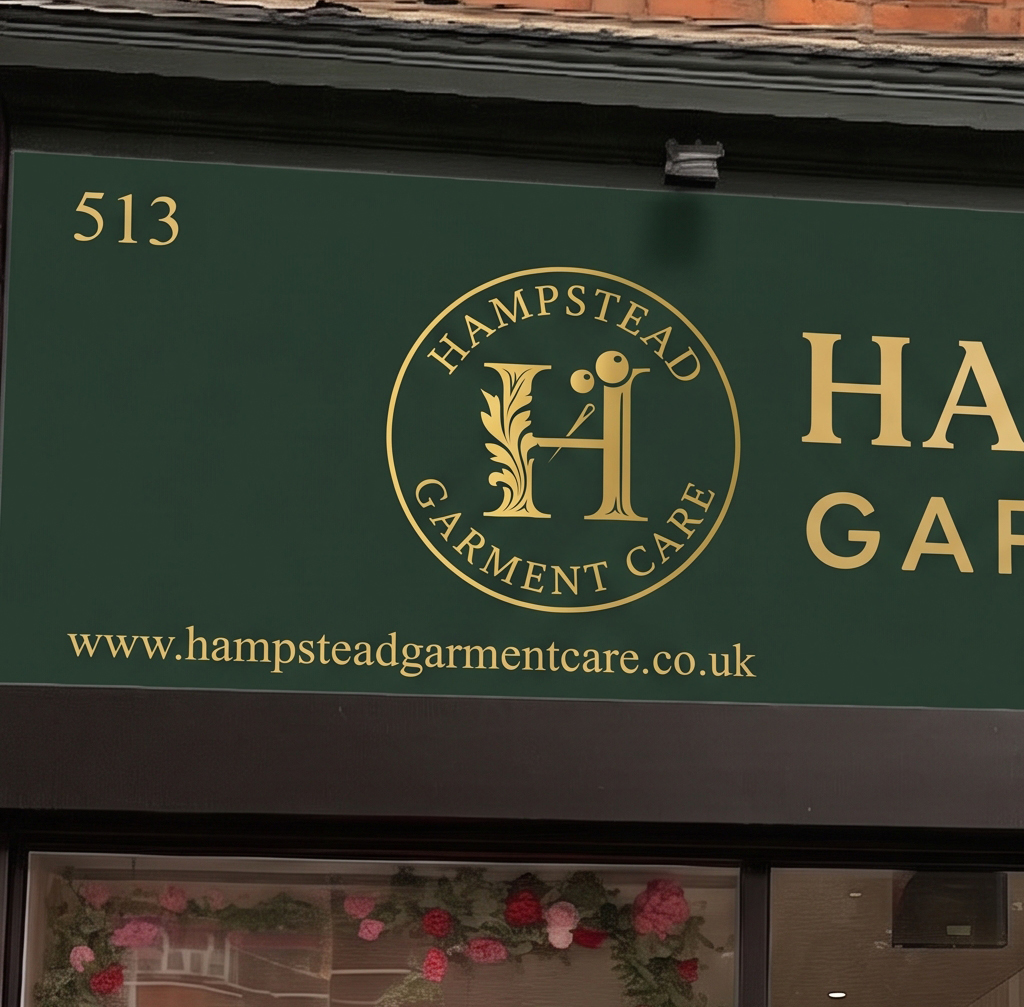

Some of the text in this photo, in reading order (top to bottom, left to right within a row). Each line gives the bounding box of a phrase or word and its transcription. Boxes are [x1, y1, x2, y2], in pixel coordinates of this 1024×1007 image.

[73, 191, 180, 246] 513
[426, 283, 702, 382] HAMPSTEAD
[414, 477, 716, 596] GARMENT CARE
[67, 625, 757, 679] www.hampsteadgarmentcare.co.uk
